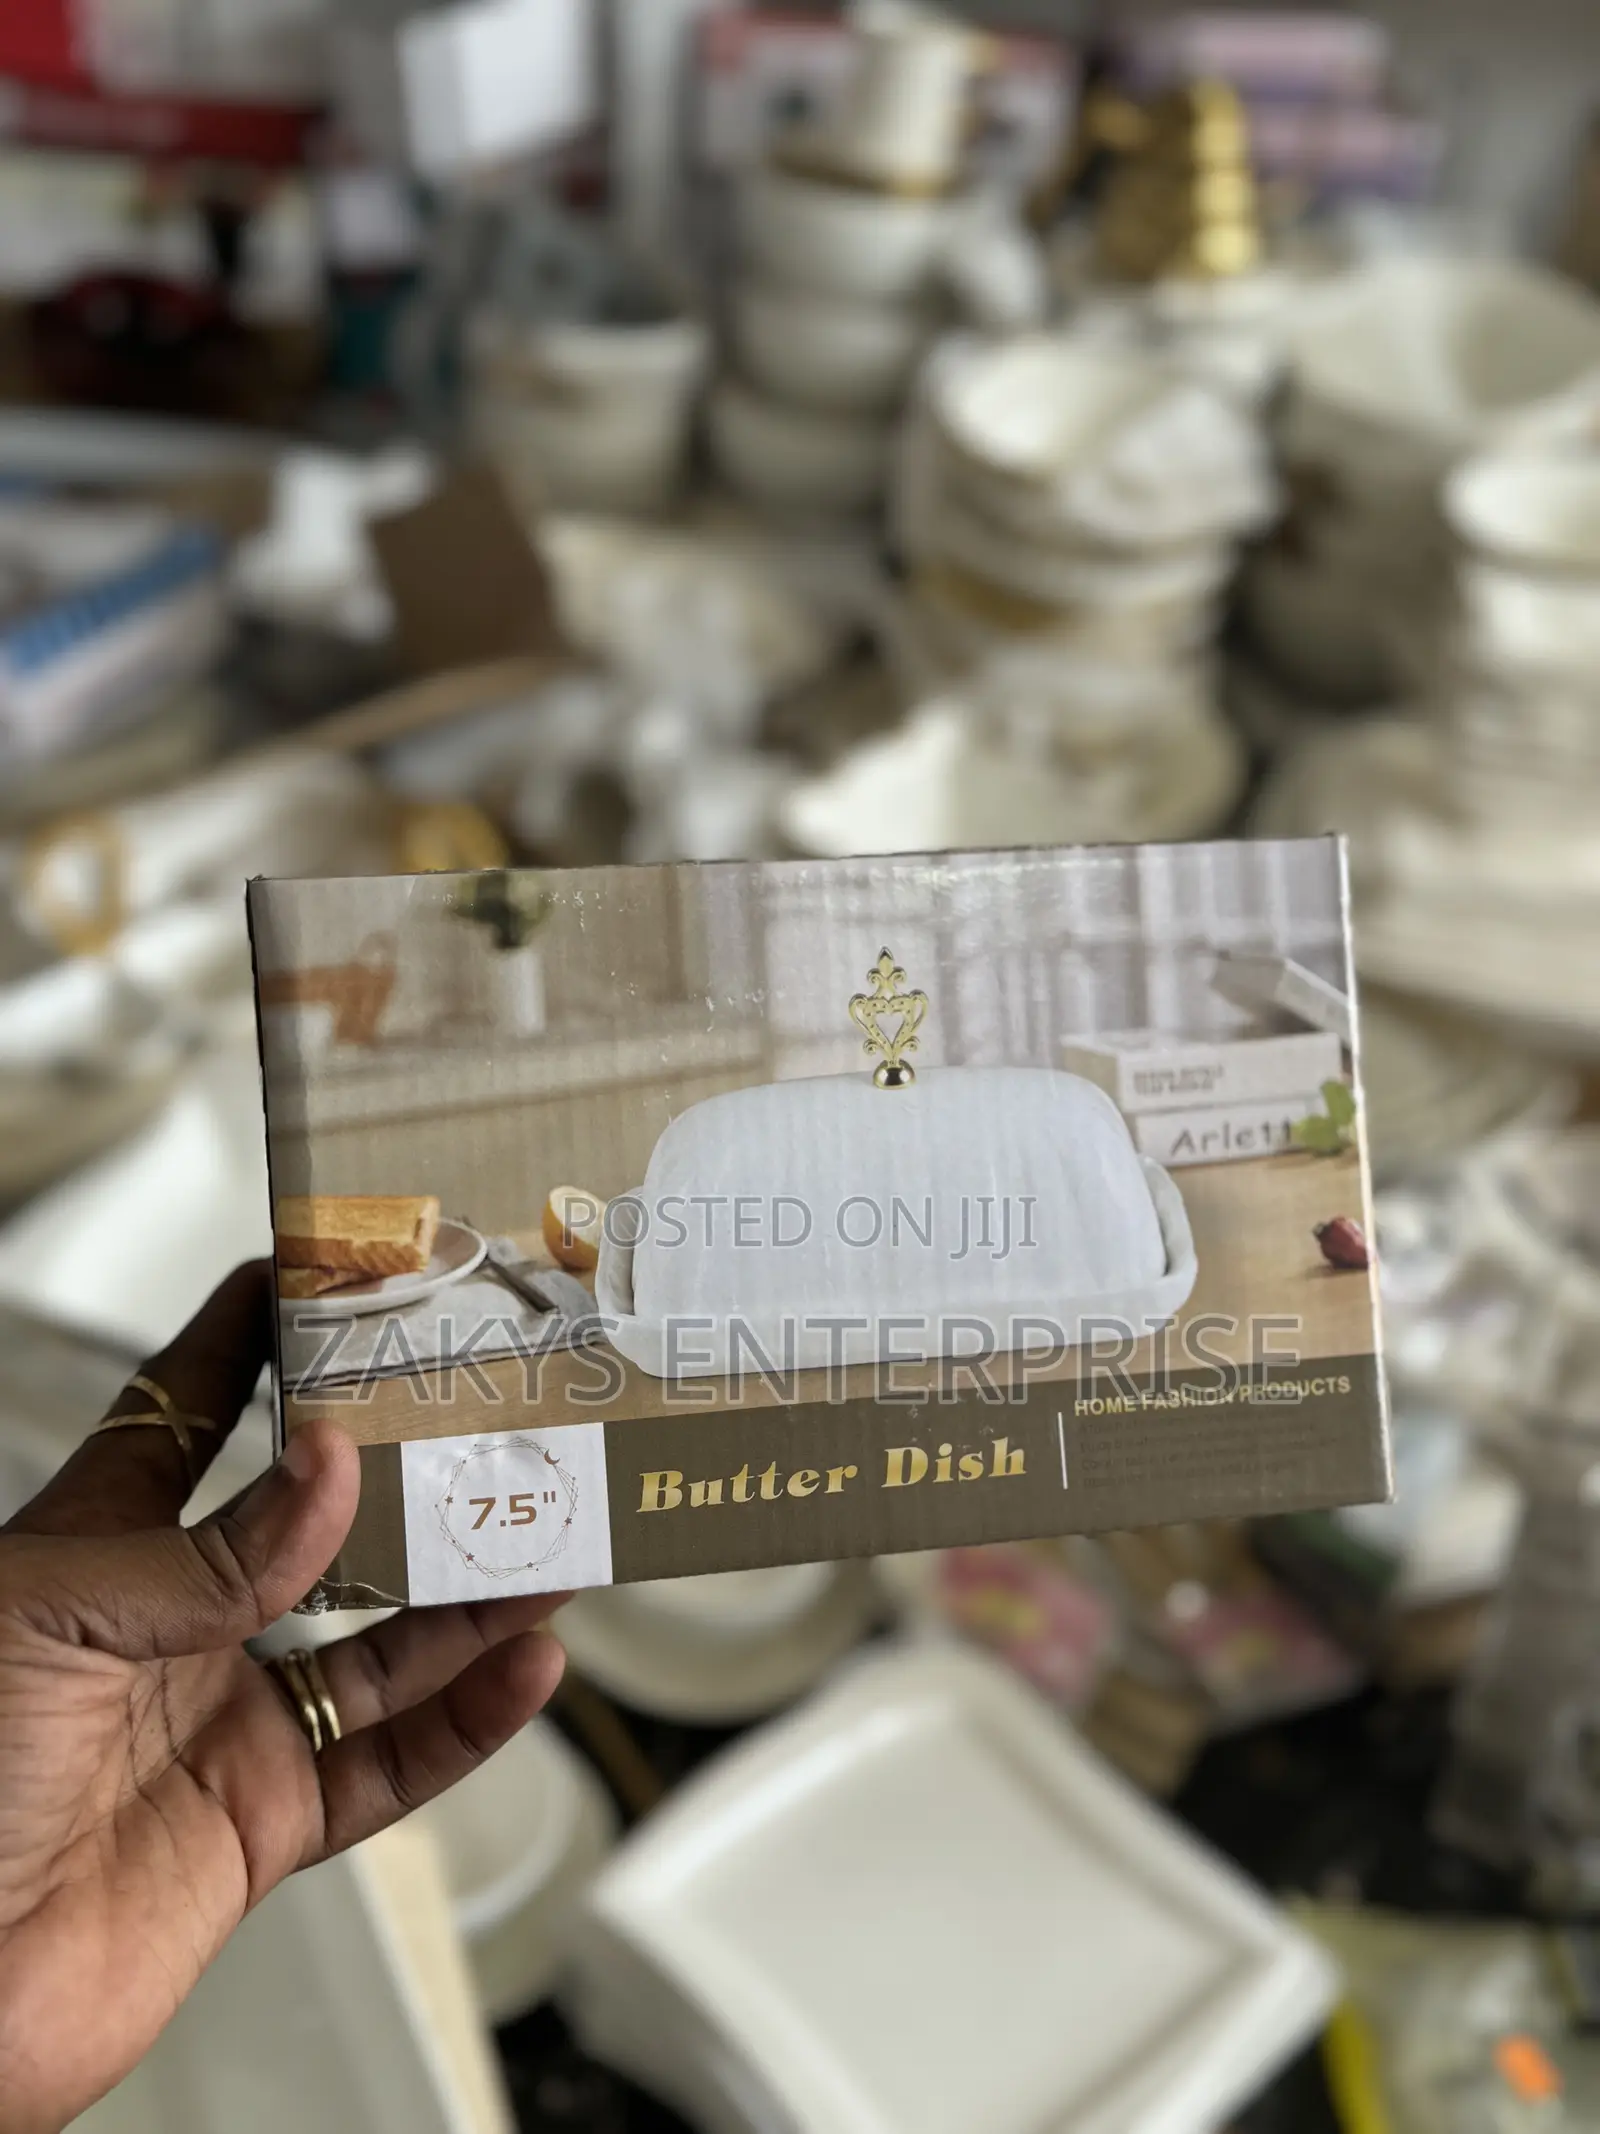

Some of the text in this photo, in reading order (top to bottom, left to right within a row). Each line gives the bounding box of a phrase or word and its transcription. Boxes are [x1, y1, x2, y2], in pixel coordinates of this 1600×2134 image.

[1074, 1375, 1351, 1417] HOME FASHION PRODUCTS
[636, 1463, 859, 1513] Butter
[881, 1437, 1028, 1489] Dish
[468, 1490, 557, 1530] 7.5"
